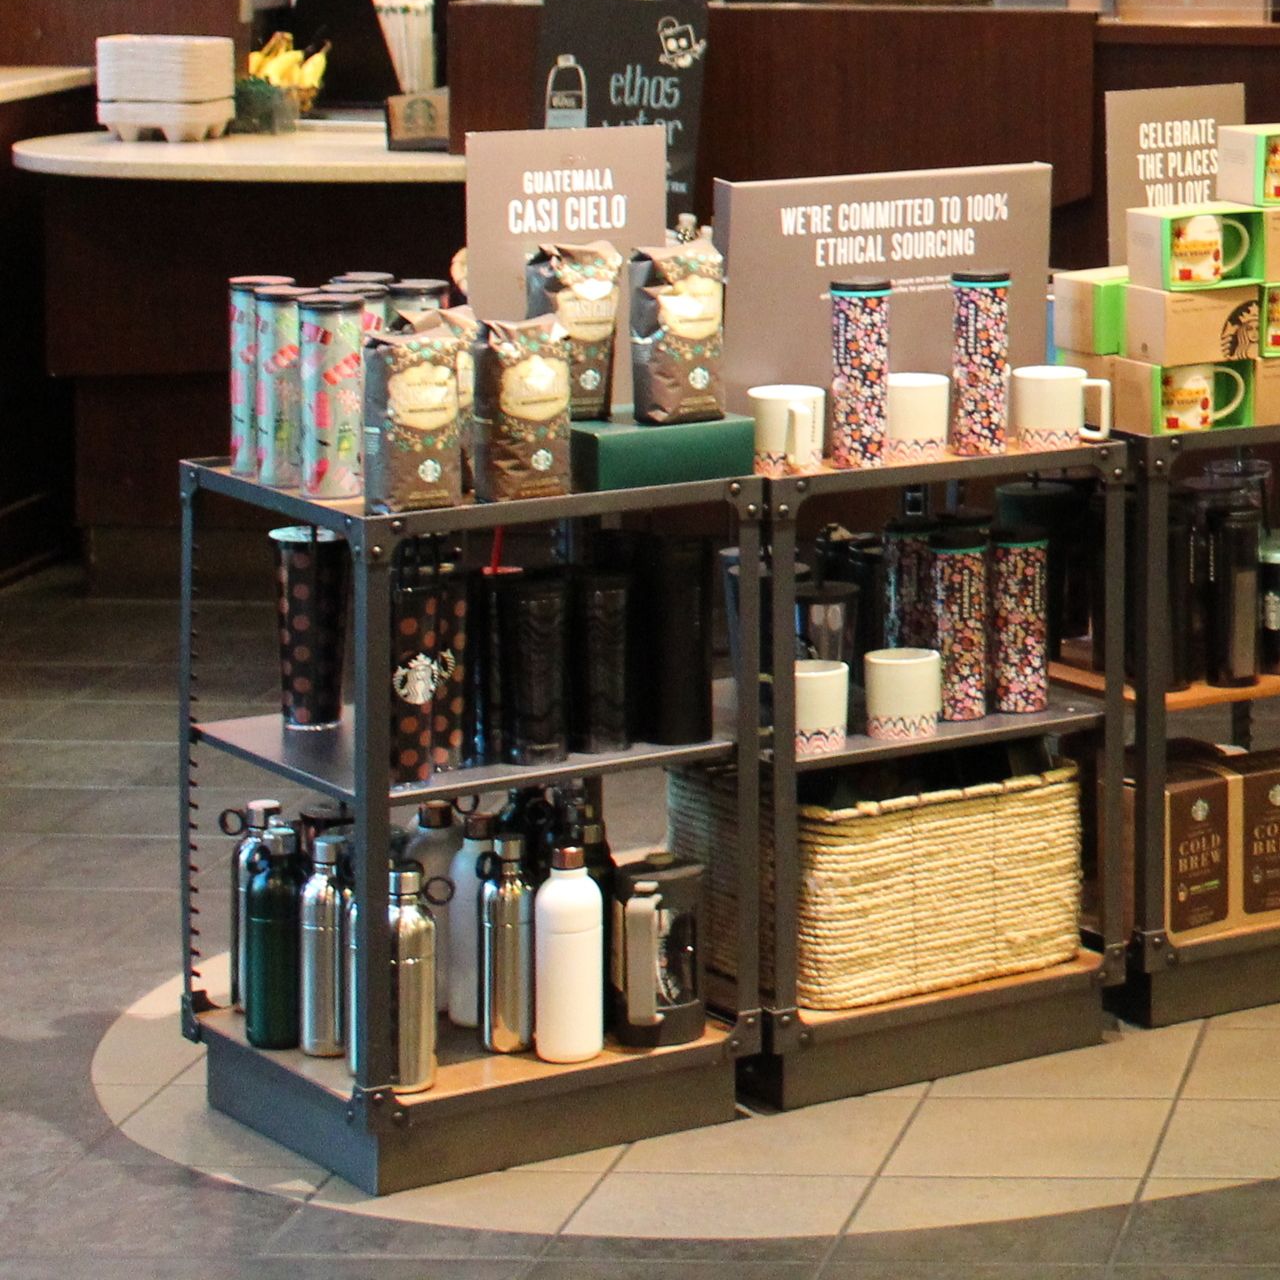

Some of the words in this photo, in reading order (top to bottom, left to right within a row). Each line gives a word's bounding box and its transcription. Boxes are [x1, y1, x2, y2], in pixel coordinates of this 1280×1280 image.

[610, 64, 680, 109] ethos
[1139, 118, 1215, 149] CELEBRATE
[1136, 152, 1164, 180] THE
[1167, 148, 1219, 178] PLACES
[523, 169, 613, 194] GUATEMALA
[1145, 182, 1173, 208] YOU
[1177, 179, 1210, 204] LOVE
[508, 198, 560, 235] CASI
[565, 194, 628, 231] CIELO
[781, 205, 832, 236] WE'RE
[837, 197, 935, 233] COMMITTED
[940, 195, 961, 224] TO
[966, 192, 1009, 222] 100%
[815, 235, 886, 267] ETHICAL
[891, 228, 976, 261] SOURCING
[1179, 833, 1221, 856] COLD
[1179, 849, 1221, 873] BREW
